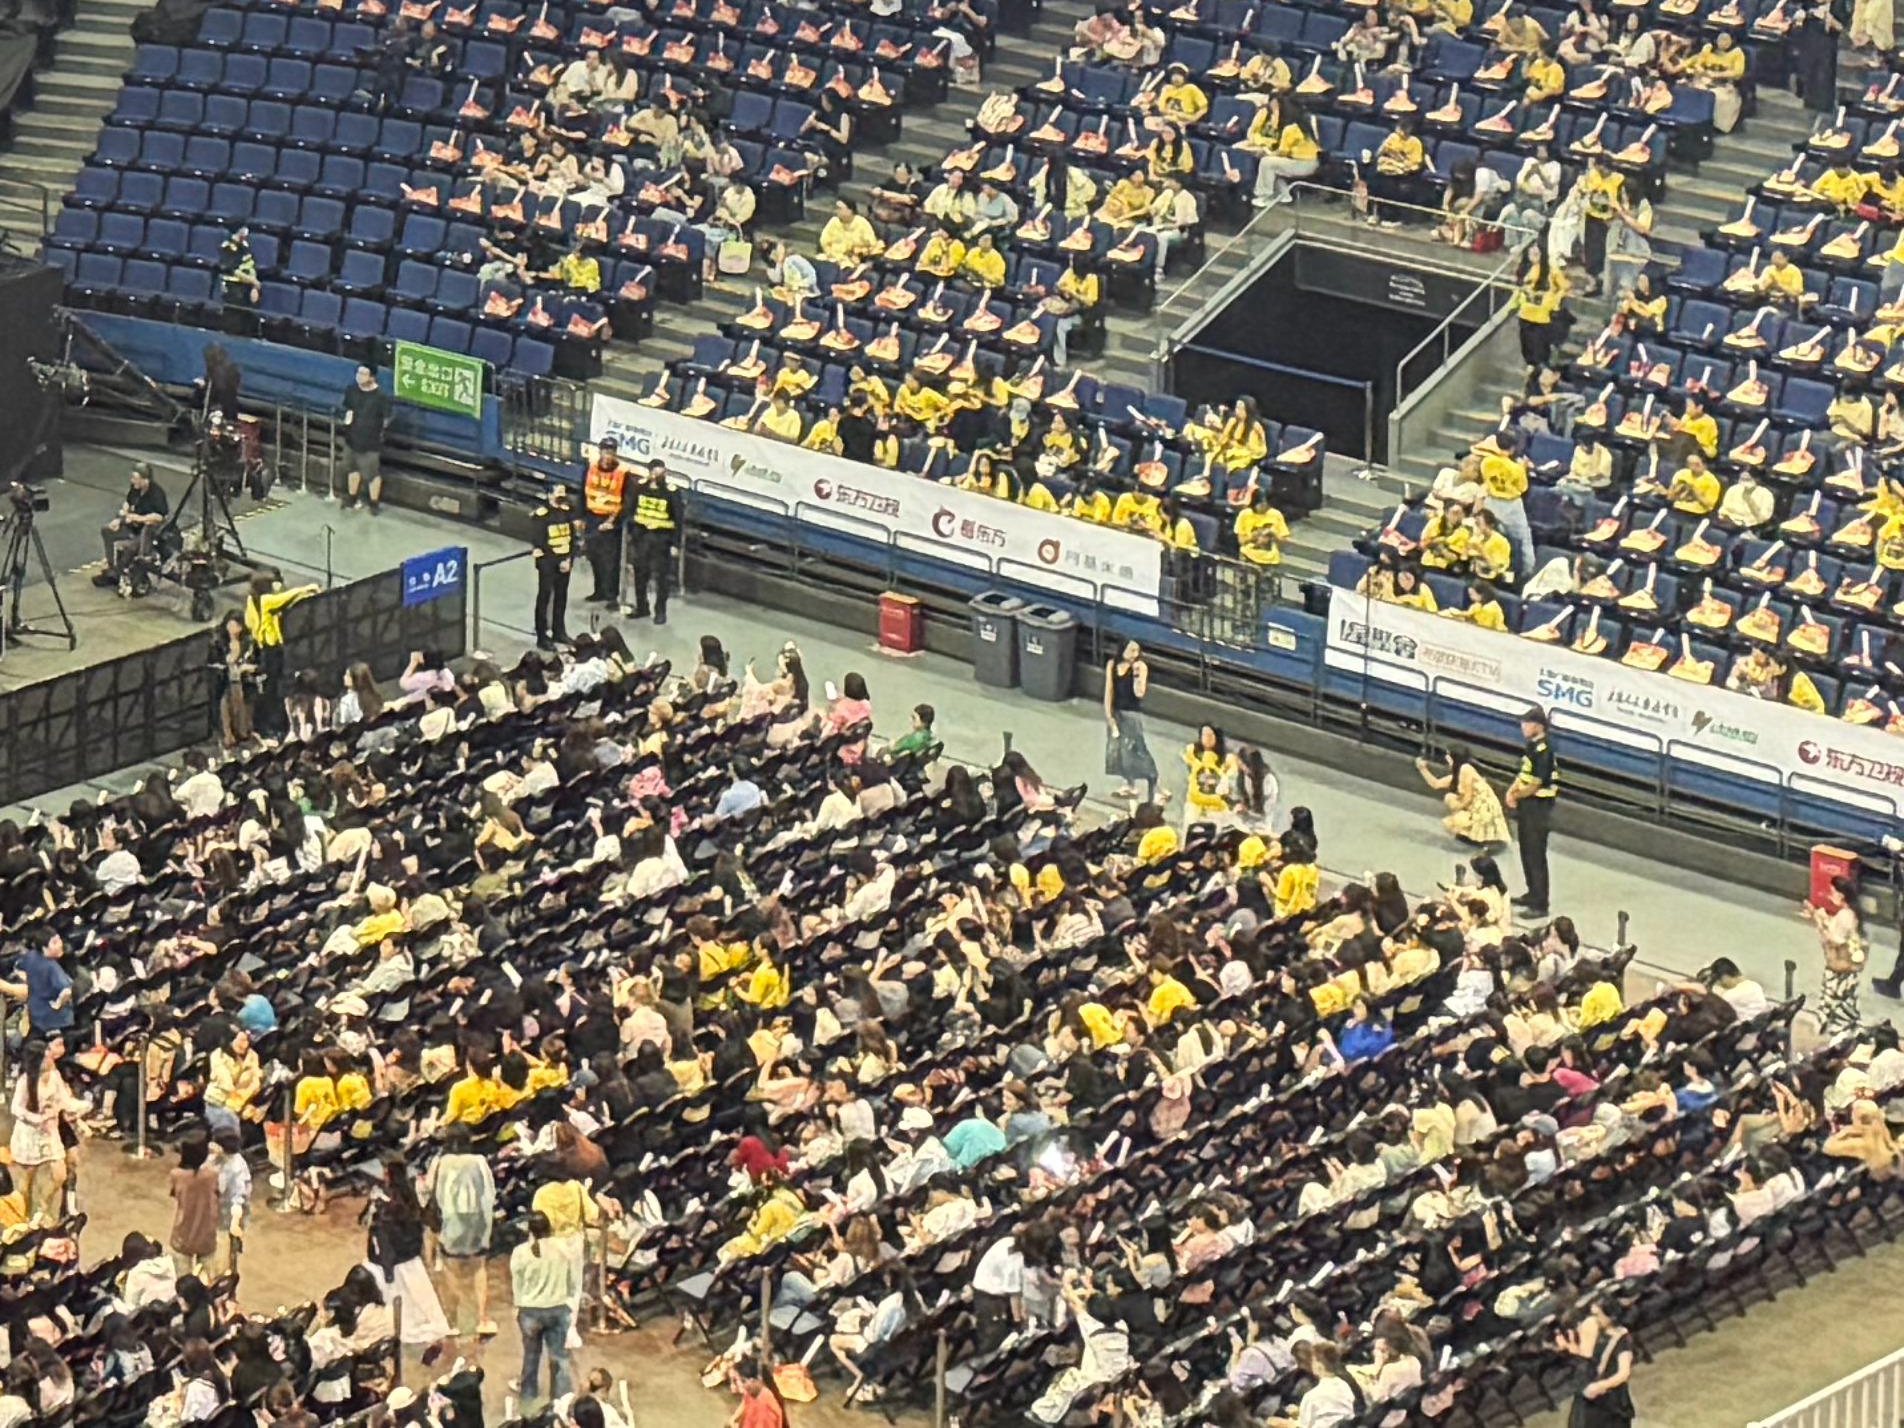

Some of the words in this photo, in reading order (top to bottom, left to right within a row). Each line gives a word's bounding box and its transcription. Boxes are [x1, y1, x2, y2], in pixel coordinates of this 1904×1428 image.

[421, 378, 450, 398] EXIT
[432, 560, 458, 587] A2
[1537, 679, 1593, 708] SMG
